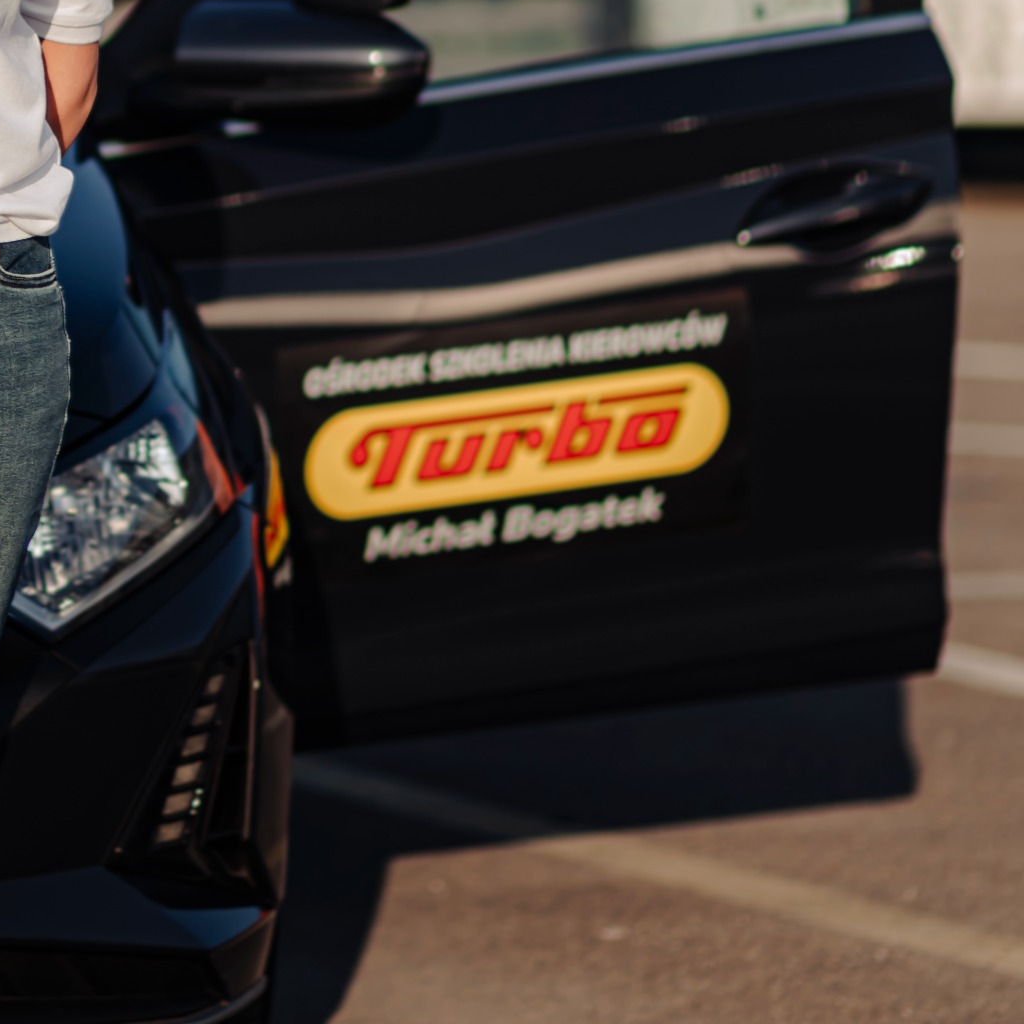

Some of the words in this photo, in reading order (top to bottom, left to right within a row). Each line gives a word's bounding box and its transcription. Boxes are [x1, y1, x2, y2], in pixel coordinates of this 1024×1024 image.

[303, 353, 427, 399] OŚRODEK
[429, 333, 566, 382] SZKOLENIA
[569, 311, 727, 363] KIEROWCÓW
[350, 386, 687, 489] Turbo
[501, 486, 665, 543] Bogatek
